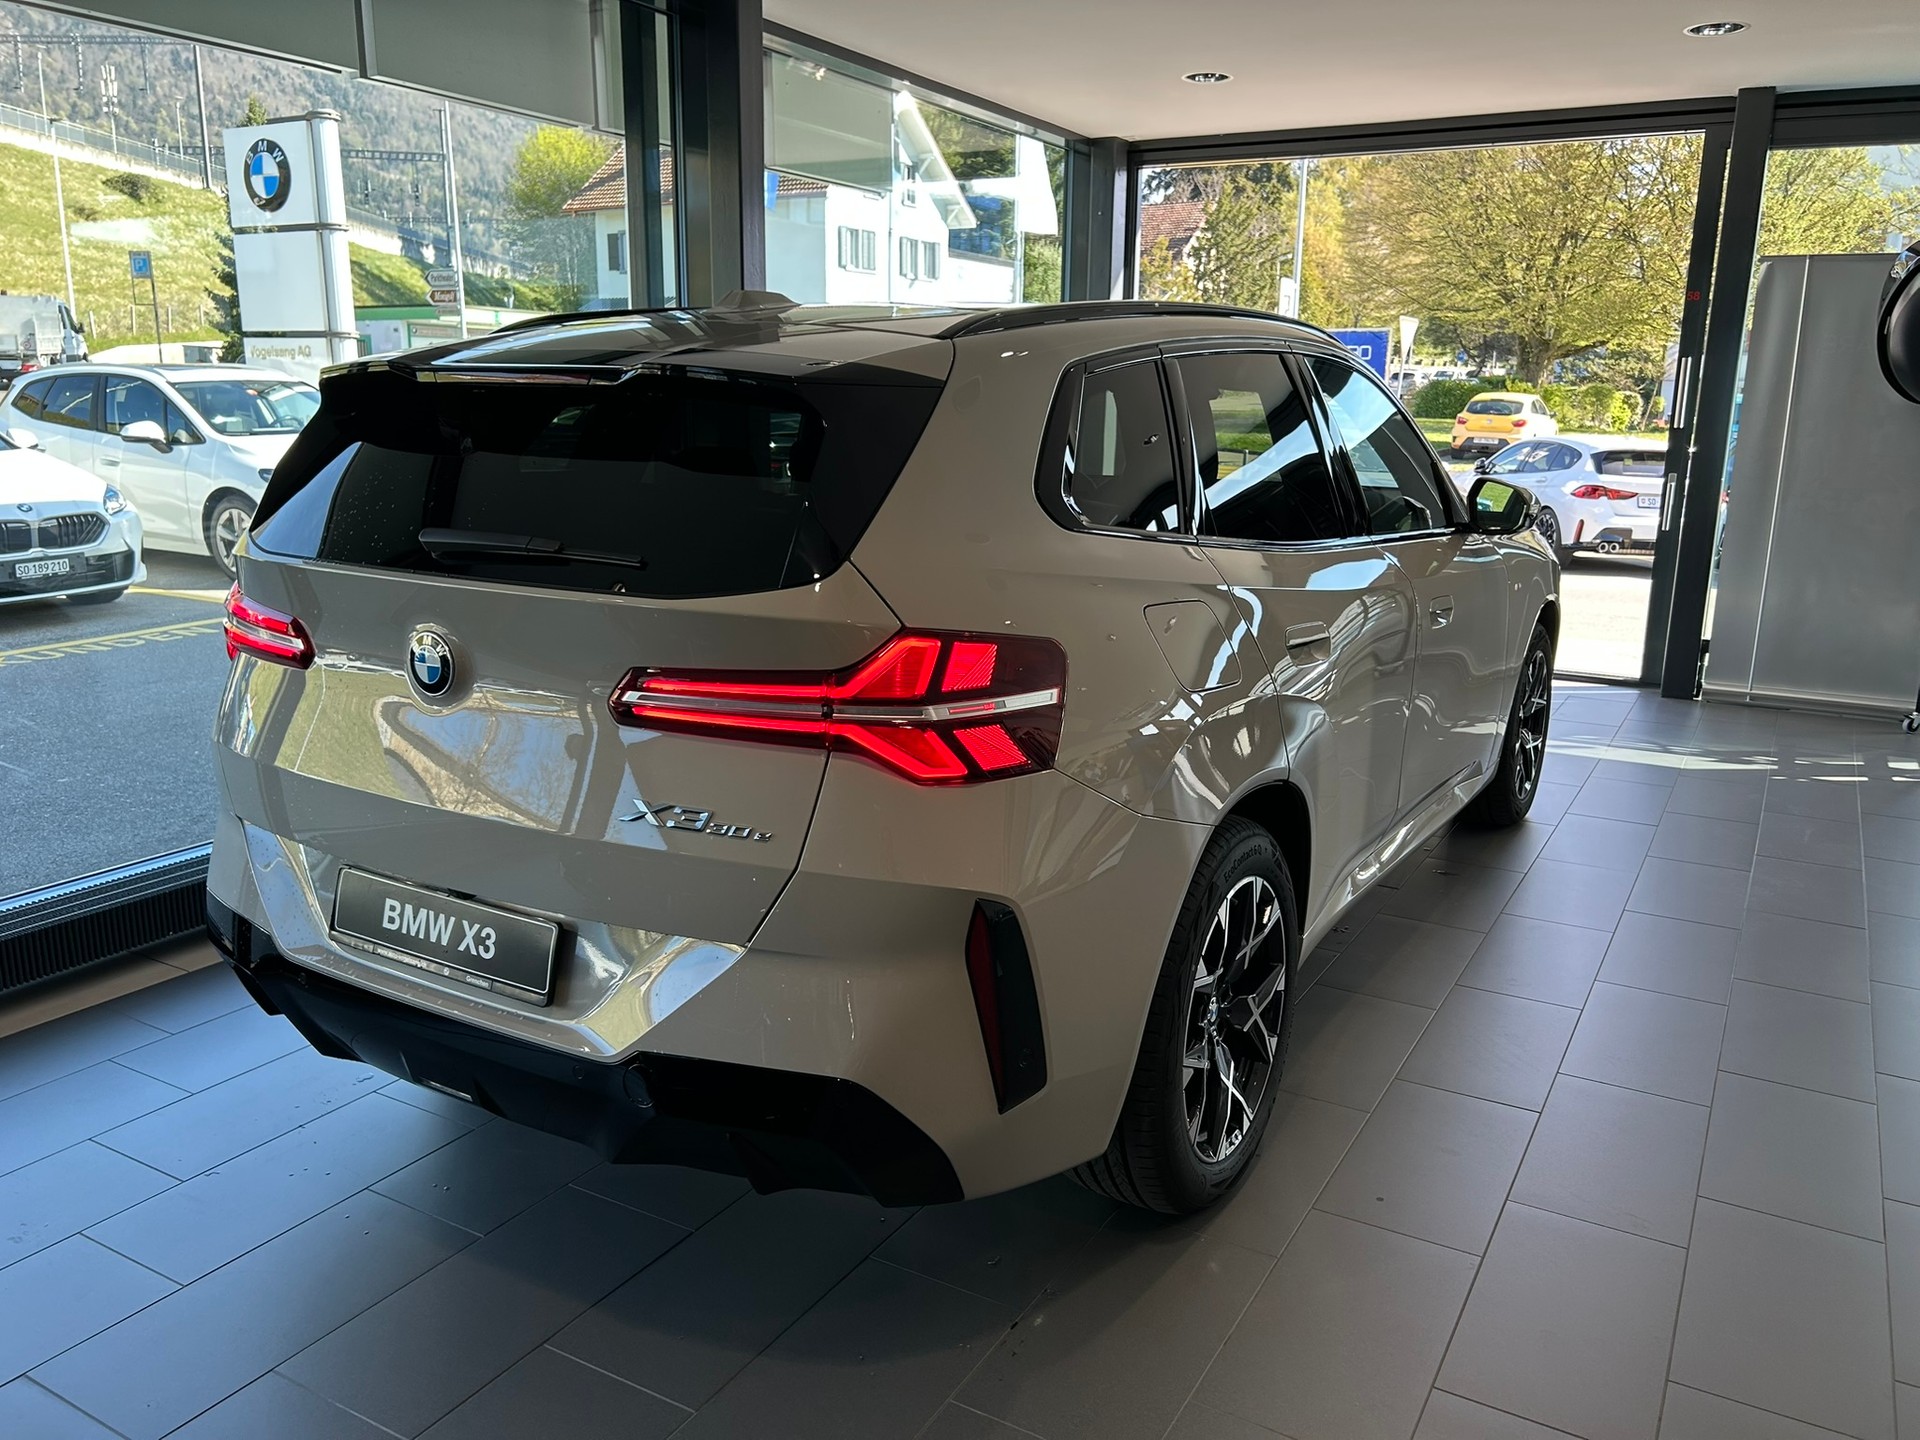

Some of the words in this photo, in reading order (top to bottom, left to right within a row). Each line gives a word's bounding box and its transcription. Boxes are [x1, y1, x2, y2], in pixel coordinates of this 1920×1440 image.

[246, 140, 285, 165] BMW
[297, 344, 312, 358] AG
[617, 798, 713, 832] X3
[382, 897, 456, 946] BMW
[457, 919, 497, 960] X3
